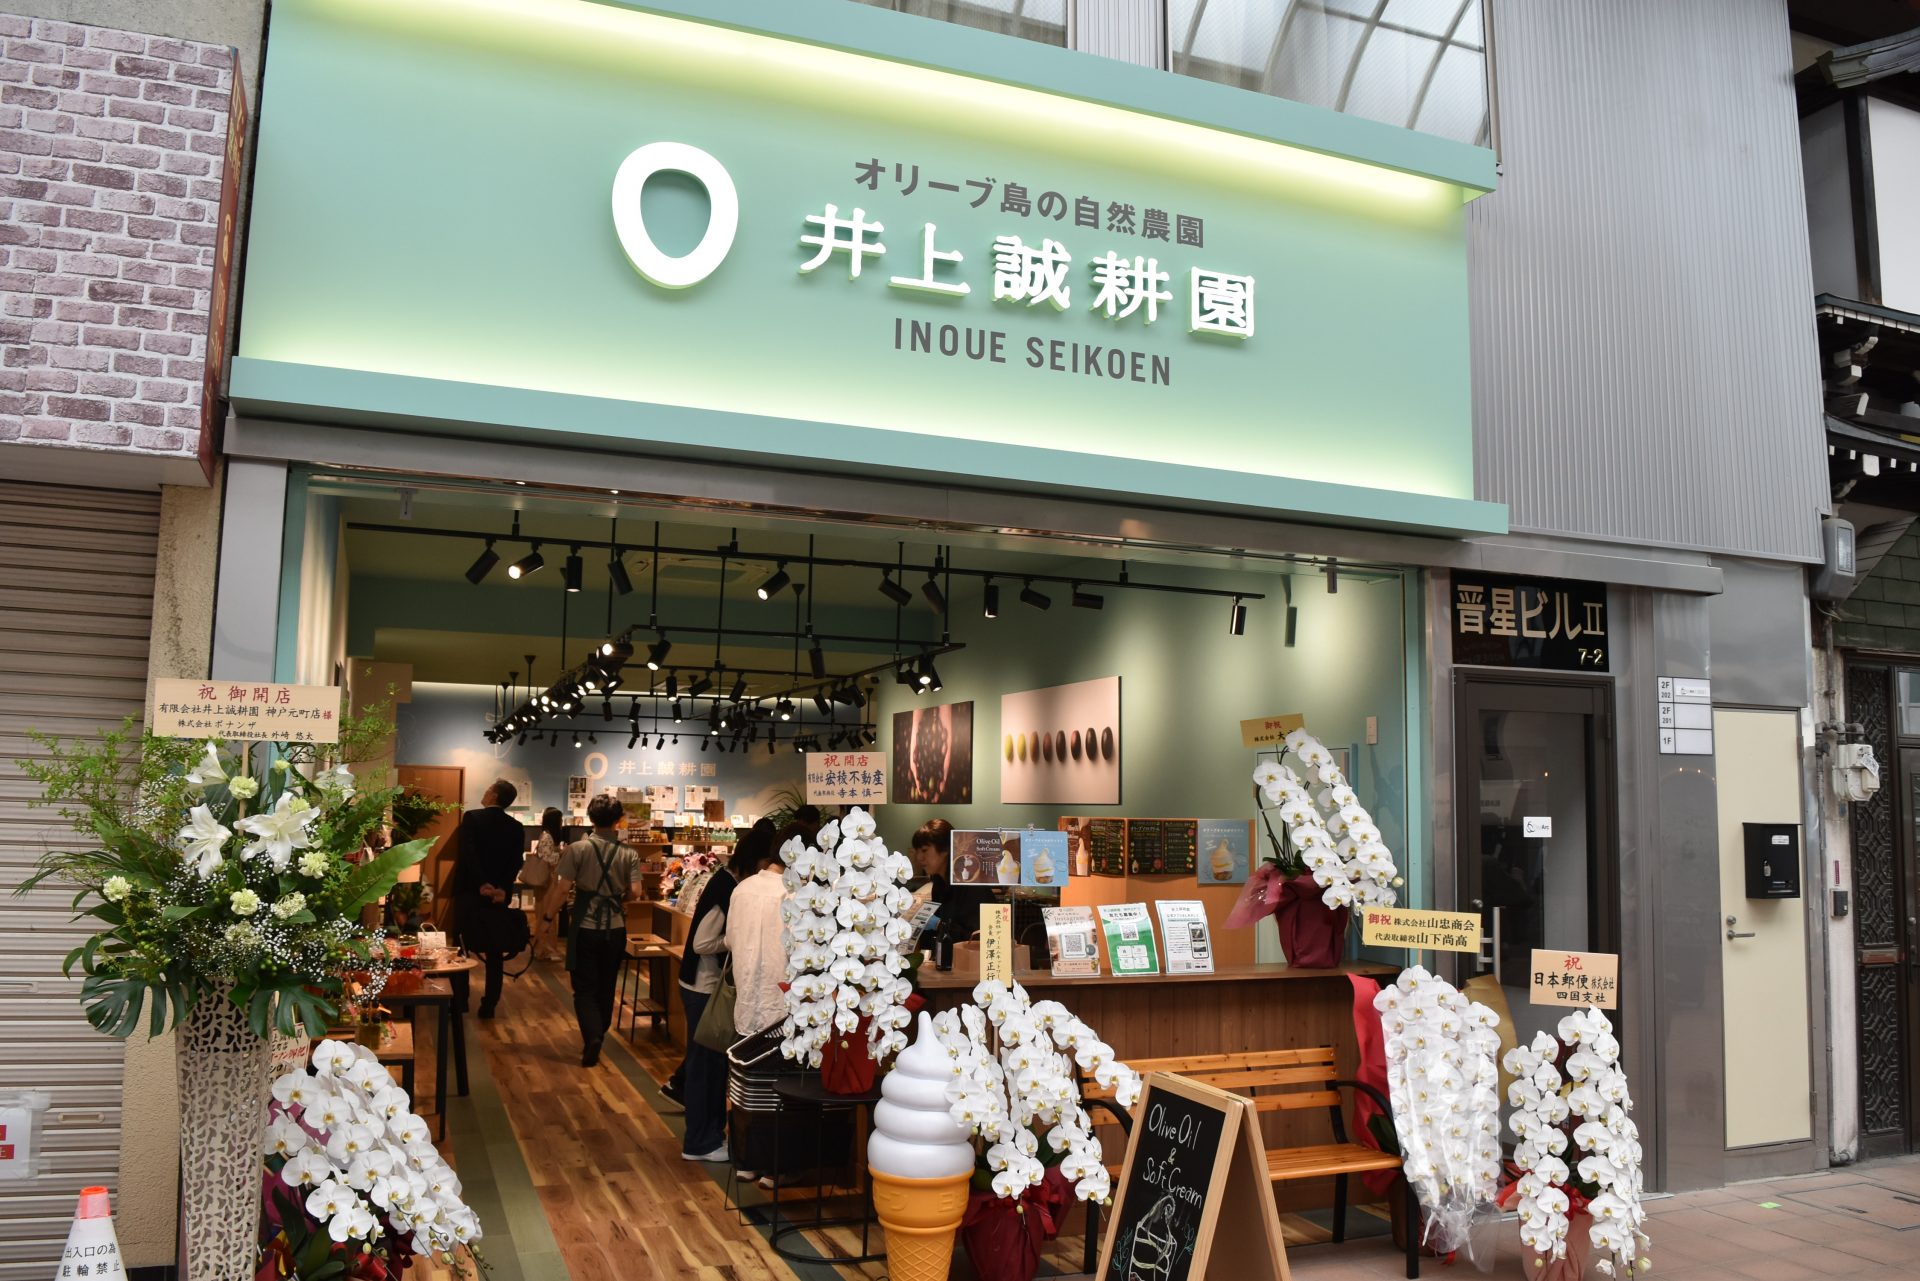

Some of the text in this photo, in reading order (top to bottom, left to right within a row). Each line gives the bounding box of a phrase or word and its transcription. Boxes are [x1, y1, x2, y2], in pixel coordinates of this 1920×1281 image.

[855, 157, 1204, 249] オリーブ島の自然農園
[799, 202, 1255, 341] 井上誠耕園
[894, 317, 1171, 387] INOUE SEIKOEN
[1578, 648, 1604, 665] 7-2
[1368, 913, 1392, 926] 御祝
[1564, 955, 1583, 971] 祝
[1556, 991, 1606, 1003] 四国支社
[1148, 1103, 1202, 1150] Olive Oil
[1167, 1147, 1177, 1165] &
[1168, 1167, 1203, 1208] Cream
[64, 1241, 117, 1259] 出入口の為
[62, 1259, 121, 1278] 駐輪禁止
